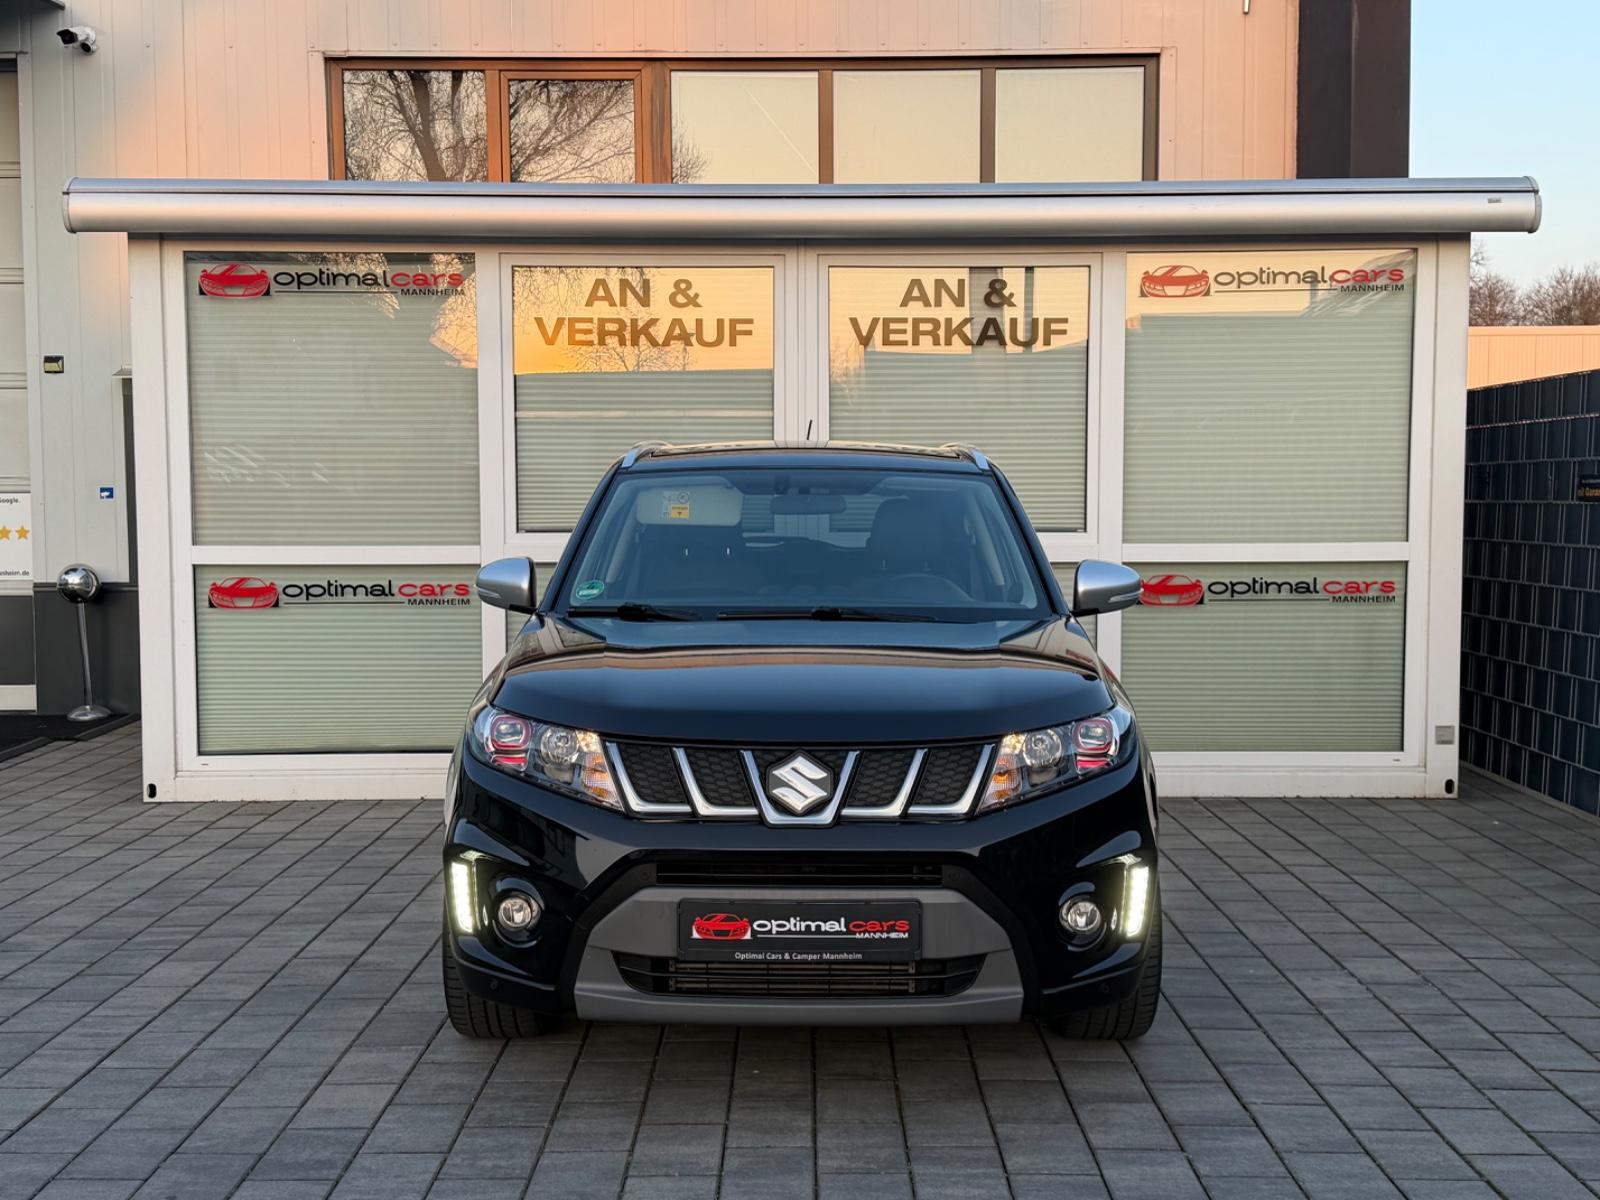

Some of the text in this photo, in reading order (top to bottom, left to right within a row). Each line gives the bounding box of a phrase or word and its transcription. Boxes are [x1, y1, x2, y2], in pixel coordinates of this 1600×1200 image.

[585, 278, 703, 309] AN &
[899, 278, 1017, 309] AN &
[1341, 284, 1405, 293] MANNHEIM
[534, 317, 754, 348] VERKAUF
[848, 317, 1069, 347] VERKAUF
[408, 598, 471, 606] MANNHEIM
[1332, 595, 1396, 604] MANNHEIM
[752, 917, 910, 934] optimal cars
[734, 951, 863, 961] Optimal Cars & Camper Mannheim
